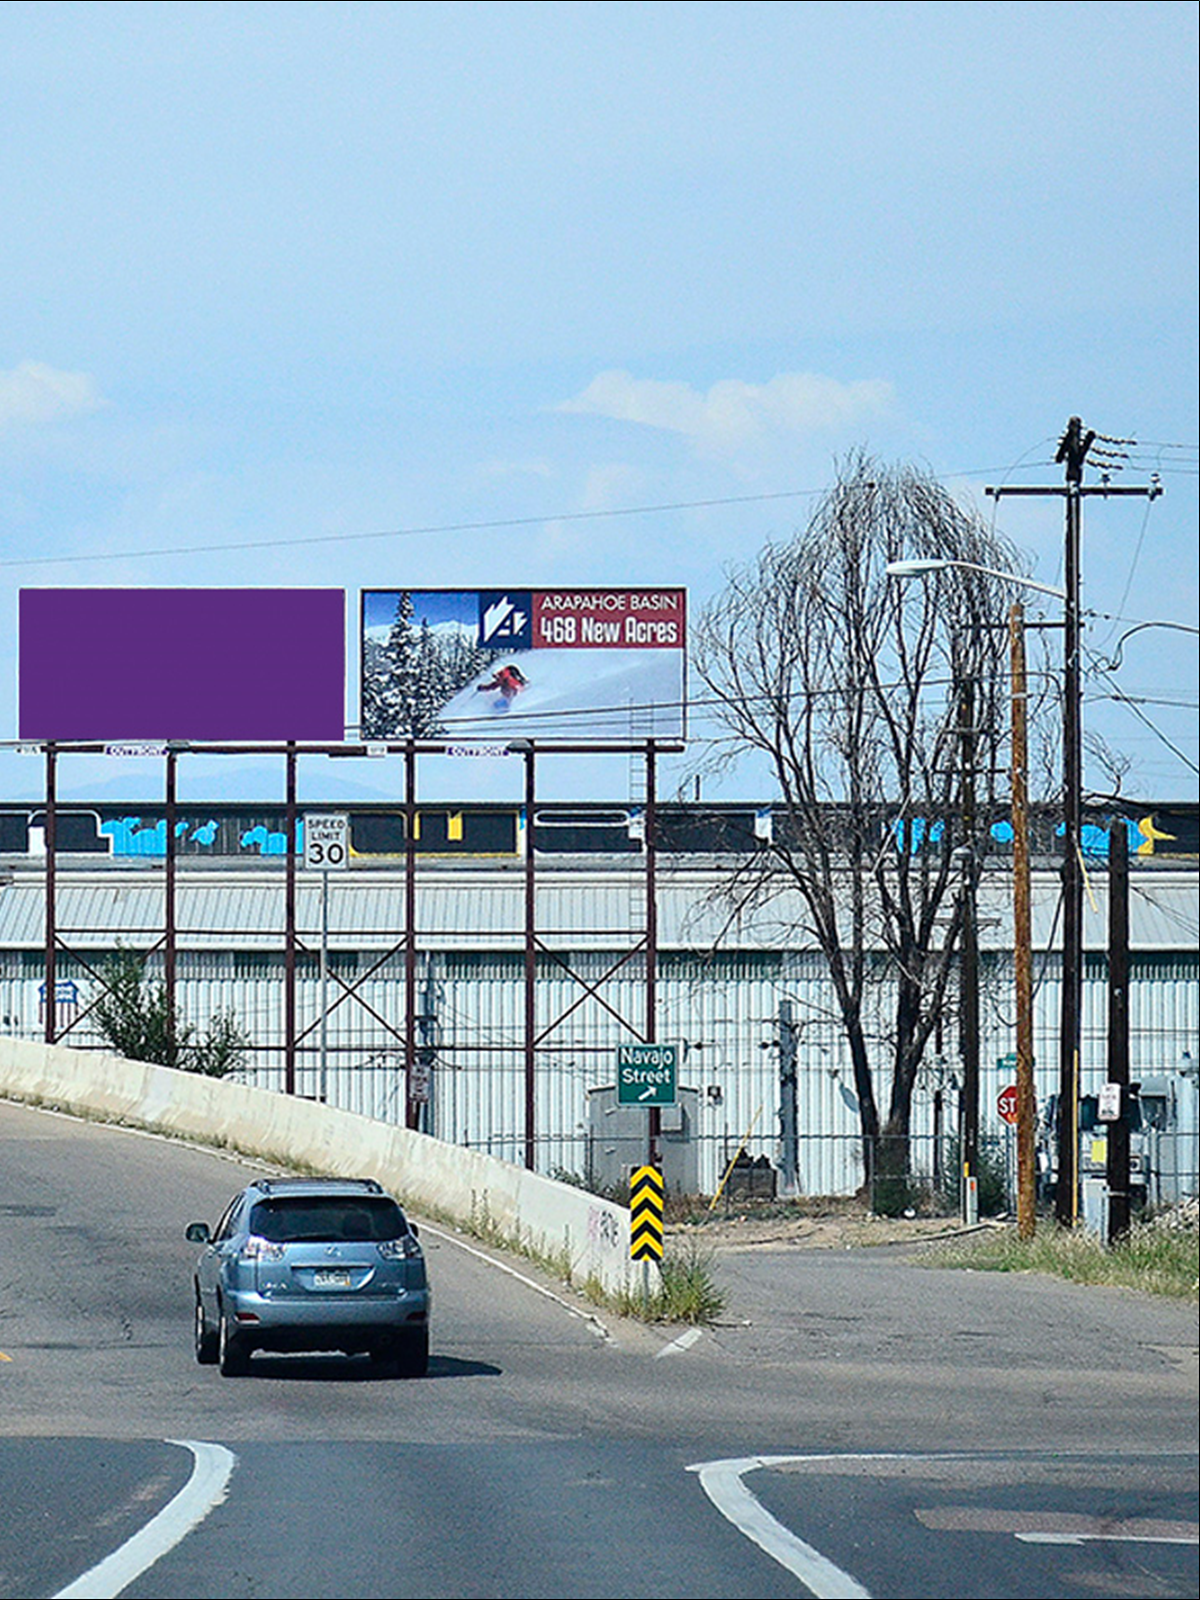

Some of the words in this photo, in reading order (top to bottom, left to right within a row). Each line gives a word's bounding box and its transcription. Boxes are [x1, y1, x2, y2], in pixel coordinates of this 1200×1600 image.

[541, 595, 626, 610] ARAPAHOE
[630, 595, 677, 610] BASIN
[541, 616, 576, 643] 468
[581, 616, 621, 643] New
[625, 616, 677, 643] Acres
[308, 819, 345, 829] SPEED
[311, 832, 340, 841] LIMIT
[309, 843, 344, 865] 30
[620, 1047, 673, 1070] Navajo
[621, 1068, 671, 1084] Street
[999, 1097, 1017, 1114] ST
